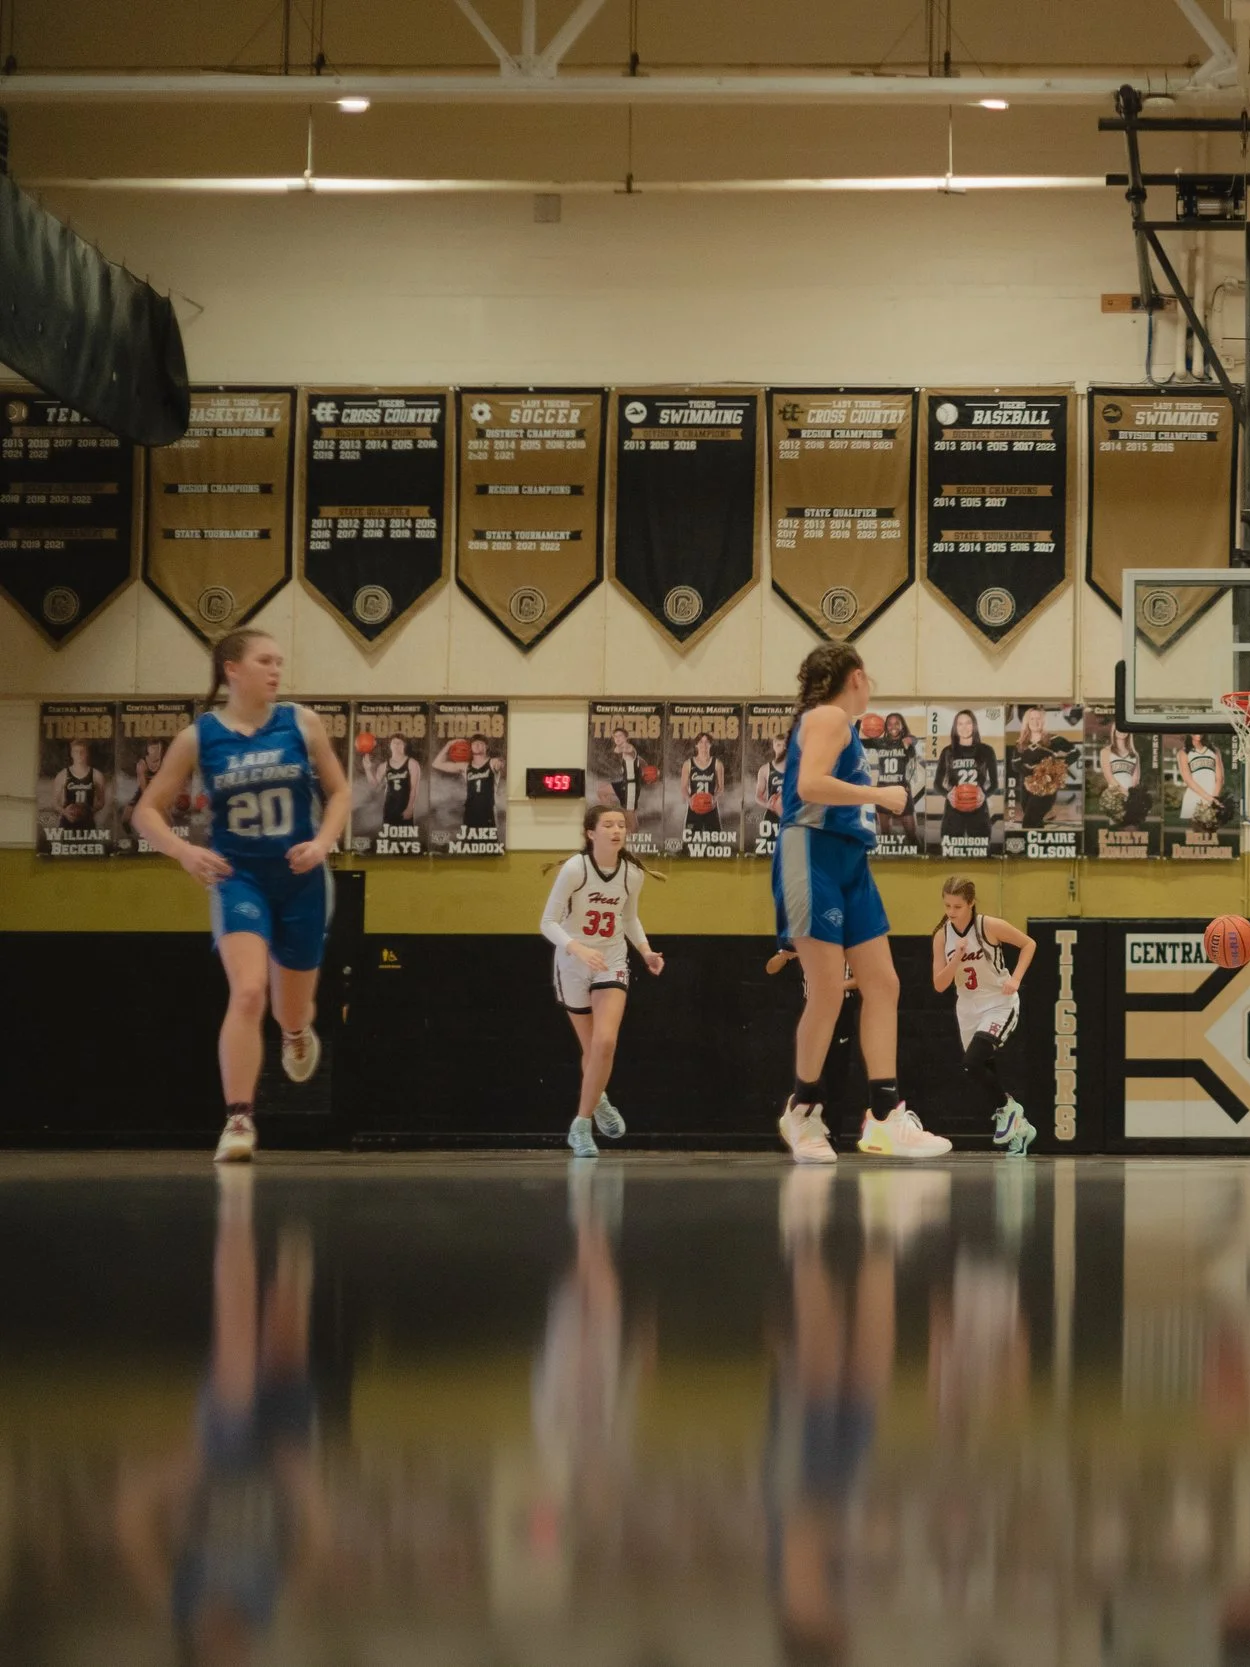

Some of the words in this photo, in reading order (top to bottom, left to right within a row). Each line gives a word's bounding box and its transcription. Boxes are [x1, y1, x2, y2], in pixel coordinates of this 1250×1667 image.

[341, 408, 381, 423] CROSS
[384, 408, 440, 423] COUNTRY
[510, 409, 580, 423] SOCCER
[660, 410, 743, 424] SWIMMING
[808, 409, 846, 423] CROSS
[850, 409, 905, 423] COUNTRY
[972, 410, 1050, 425] BASEBALL
[1135, 412, 1218, 426] SWIMMING
[801, 429, 831, 438] REGION
[834, 429, 883, 438] CHAMPIONS
[1118, 432, 1156, 440] DIVISION
[1158, 432, 1207, 440] CHAMPIONS
[804, 508, 830, 517] STATE
[833, 508, 877, 517] QUALIFIER
[486, 531, 512, 540] STATE
[126, 704, 155, 712] CENTRAL
[158, 704, 185, 712] MAGNET
[362, 705, 392, 713] CENTRAL
[394, 705, 421, 713] MAGNET
[440, 705, 469, 713] CENTRAL
[472, 705, 499, 713] MAGNET
[596, 705, 626, 713] CENTRAL
[629, 705, 656, 713] MAGNET
[43, 715, 114, 739] TIGERS
[355, 714, 426, 738] TIGERS
[434, 714, 504, 739] TIGERS
[591, 714, 661, 739] TIGERS
[670, 715, 738, 739] TIGERS
[228, 749, 284, 767] LADY
[884, 758, 898, 774] 10
[214, 764, 300, 789] FALCONS
[958, 769, 977, 786] 22
[696, 782, 709, 793] 21
[226, 788, 293, 836] 20
[44, 828, 109, 840] WILLIAM
[379, 824, 418, 838] JOHN
[456, 825, 497, 841] JAKE
[683, 829, 736, 843] CARSON
[1027, 831, 1075, 844] CLAIRE
[51, 842, 104, 855] BECKER
[376, 840, 420, 854] HAYS
[449, 842, 505, 854] MADDOX
[941, 836, 989, 847] ADDISON
[689, 844, 731, 857] WOOD
[942, 846, 987, 857] MELTON
[1027, 845, 1076, 858] OLSON
[588, 892, 620, 905] Heat
[582, 910, 615, 937] 33
[963, 967, 978, 990] 3
[1055, 930, 1077, 1140] TIGERS
